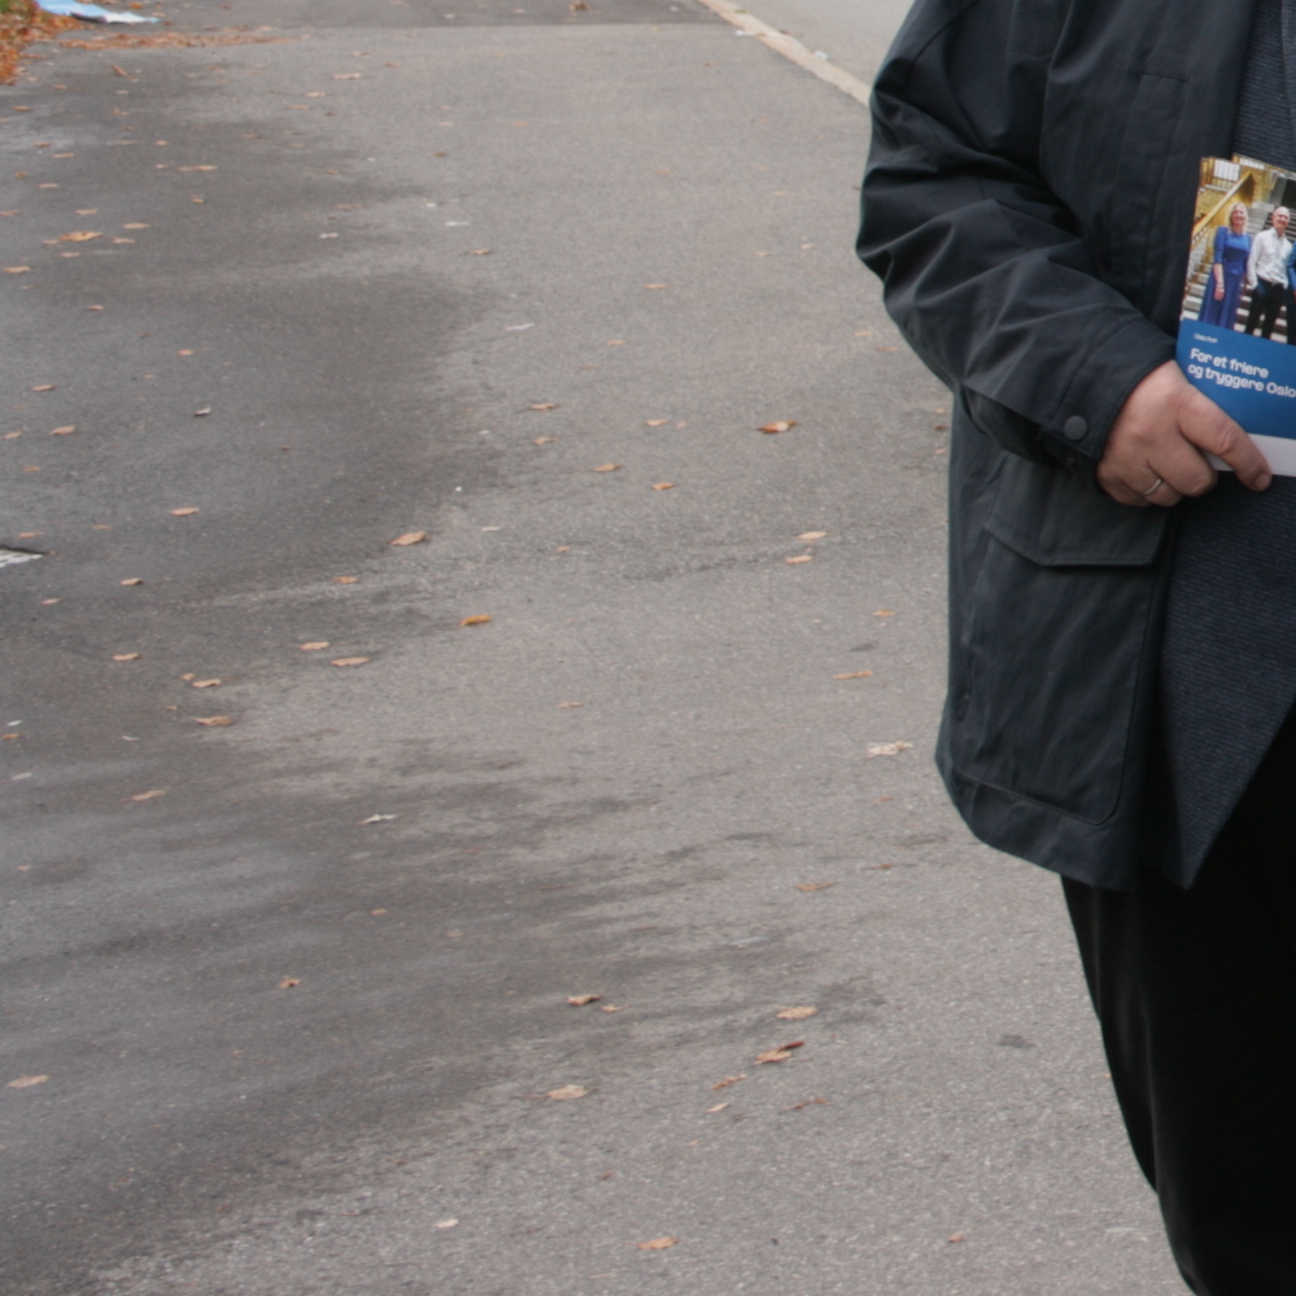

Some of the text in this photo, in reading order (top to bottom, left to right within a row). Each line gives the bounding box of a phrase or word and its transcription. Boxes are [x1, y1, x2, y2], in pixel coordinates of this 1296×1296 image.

[1190, 348, 1269, 379] For et friere
[1188, 364, 1296, 398] og tryggere Oslo
